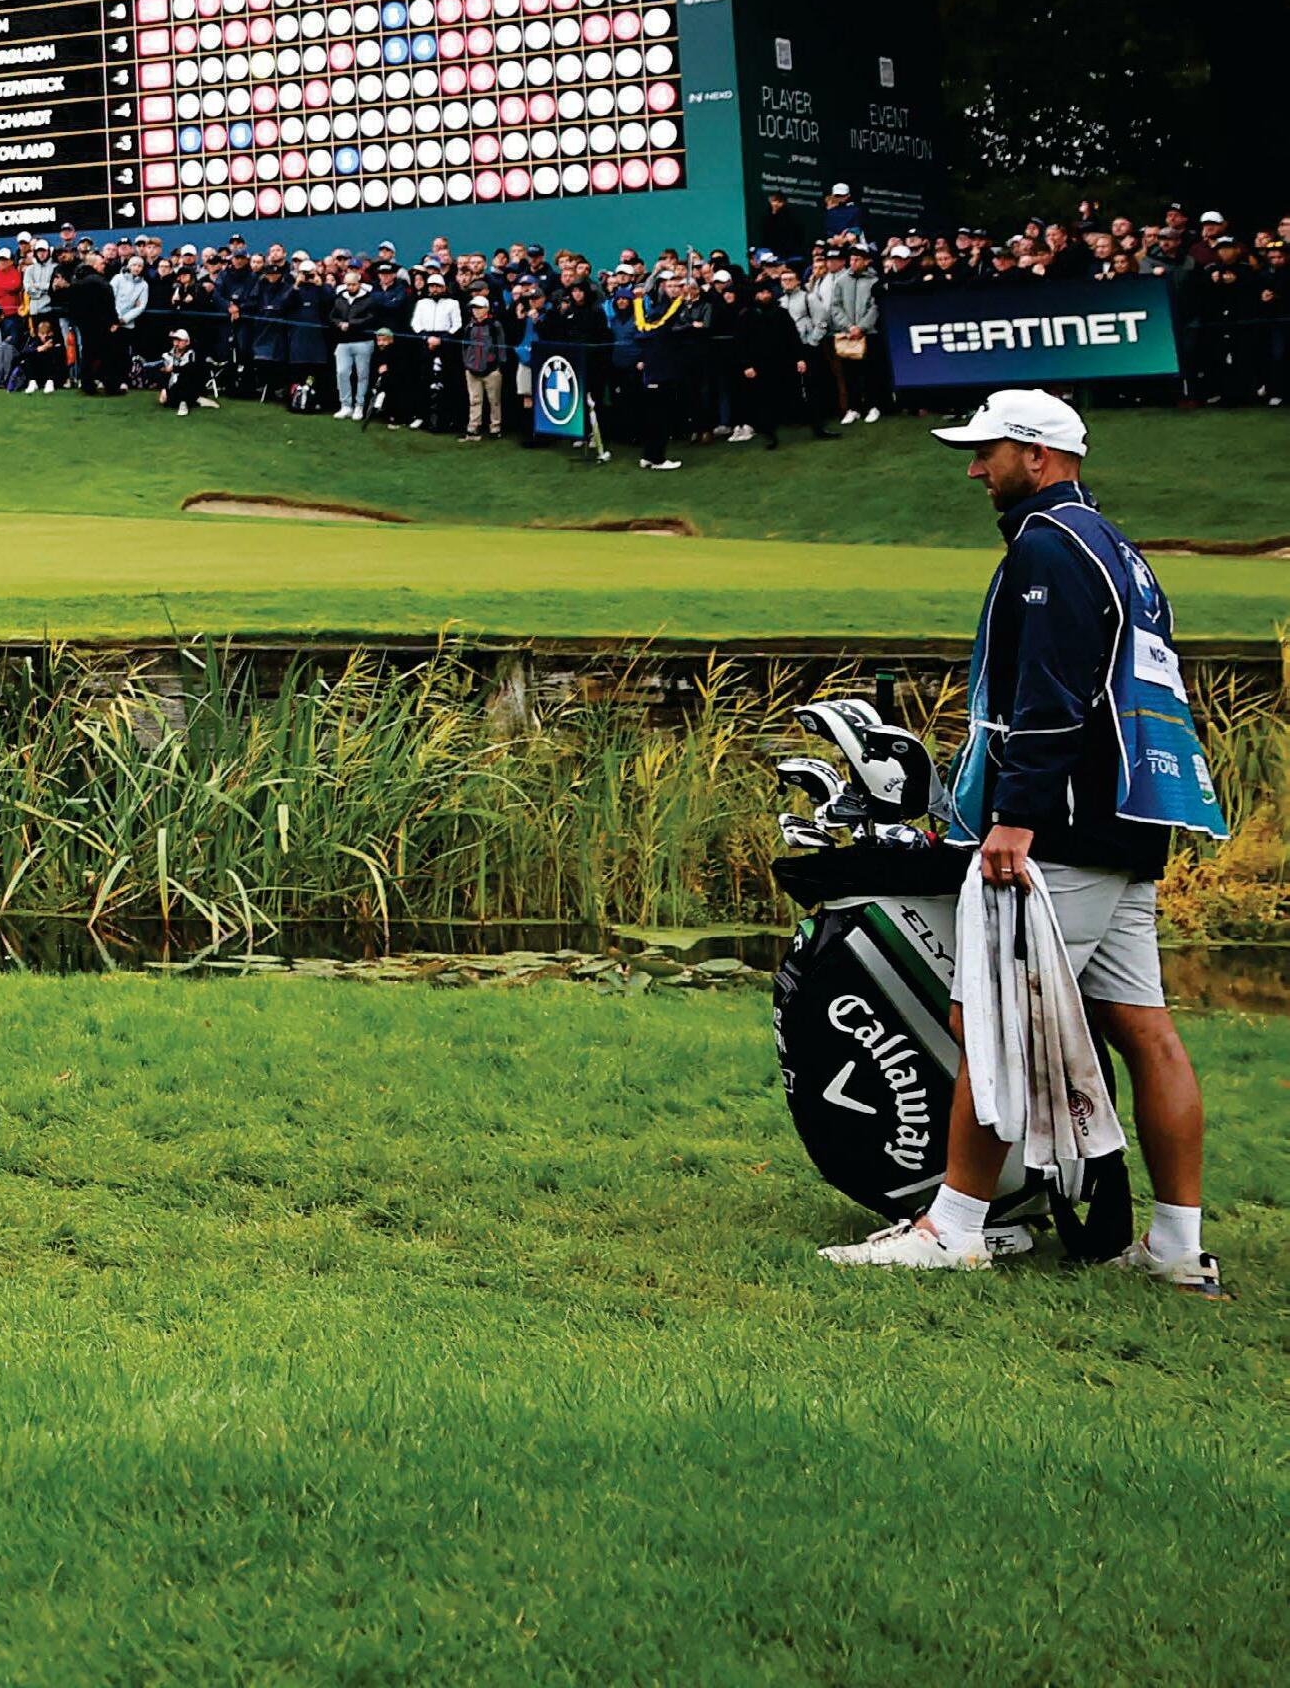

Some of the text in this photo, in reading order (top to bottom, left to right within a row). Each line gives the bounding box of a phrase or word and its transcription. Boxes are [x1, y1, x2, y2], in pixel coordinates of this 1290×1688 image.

[762, 86, 813, 115] PLAYER
[758, 114, 820, 143] LOCATOR
[869, 104, 909, 129] EVENT
[850, 128, 933, 160] INFORMATION
[909, 311, 1147, 354] FORTINET
[828, 995, 930, 1170] Callaway
